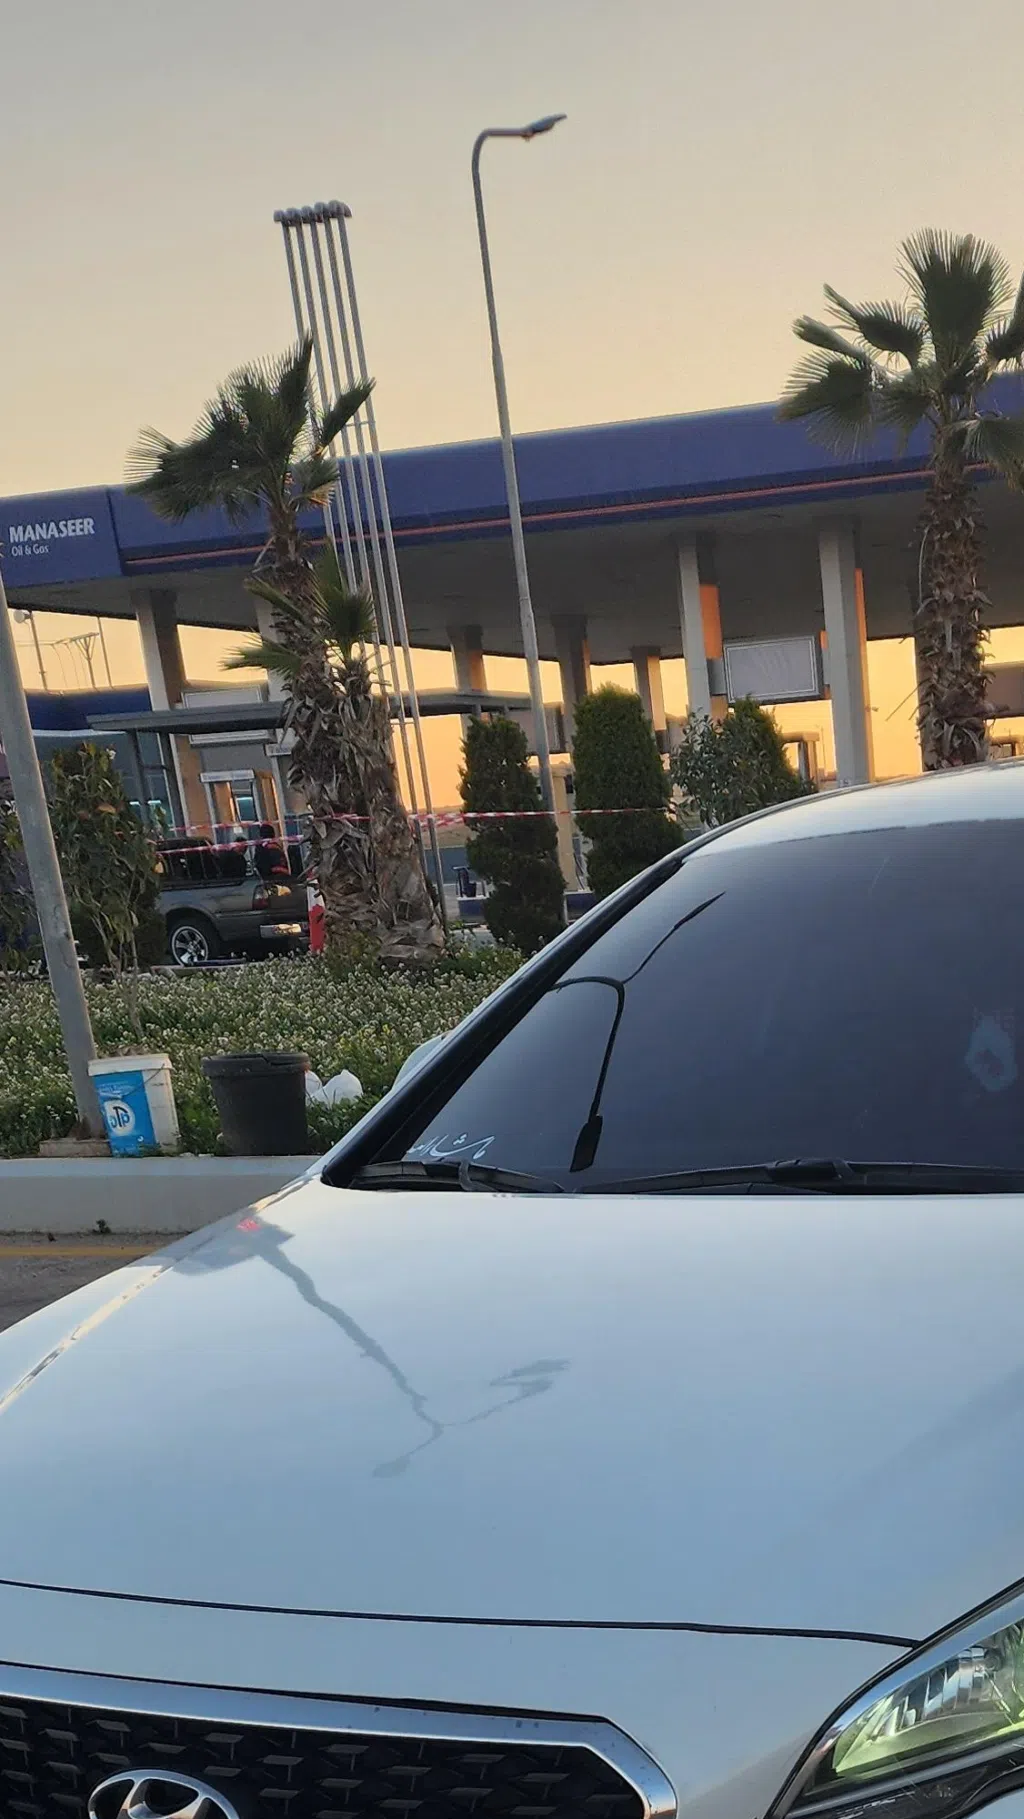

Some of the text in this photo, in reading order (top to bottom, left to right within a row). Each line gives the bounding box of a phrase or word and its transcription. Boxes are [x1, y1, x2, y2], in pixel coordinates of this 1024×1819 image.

[9, 518, 95, 543] MANASEER
[11, 543, 49, 557] Oil & Gas
